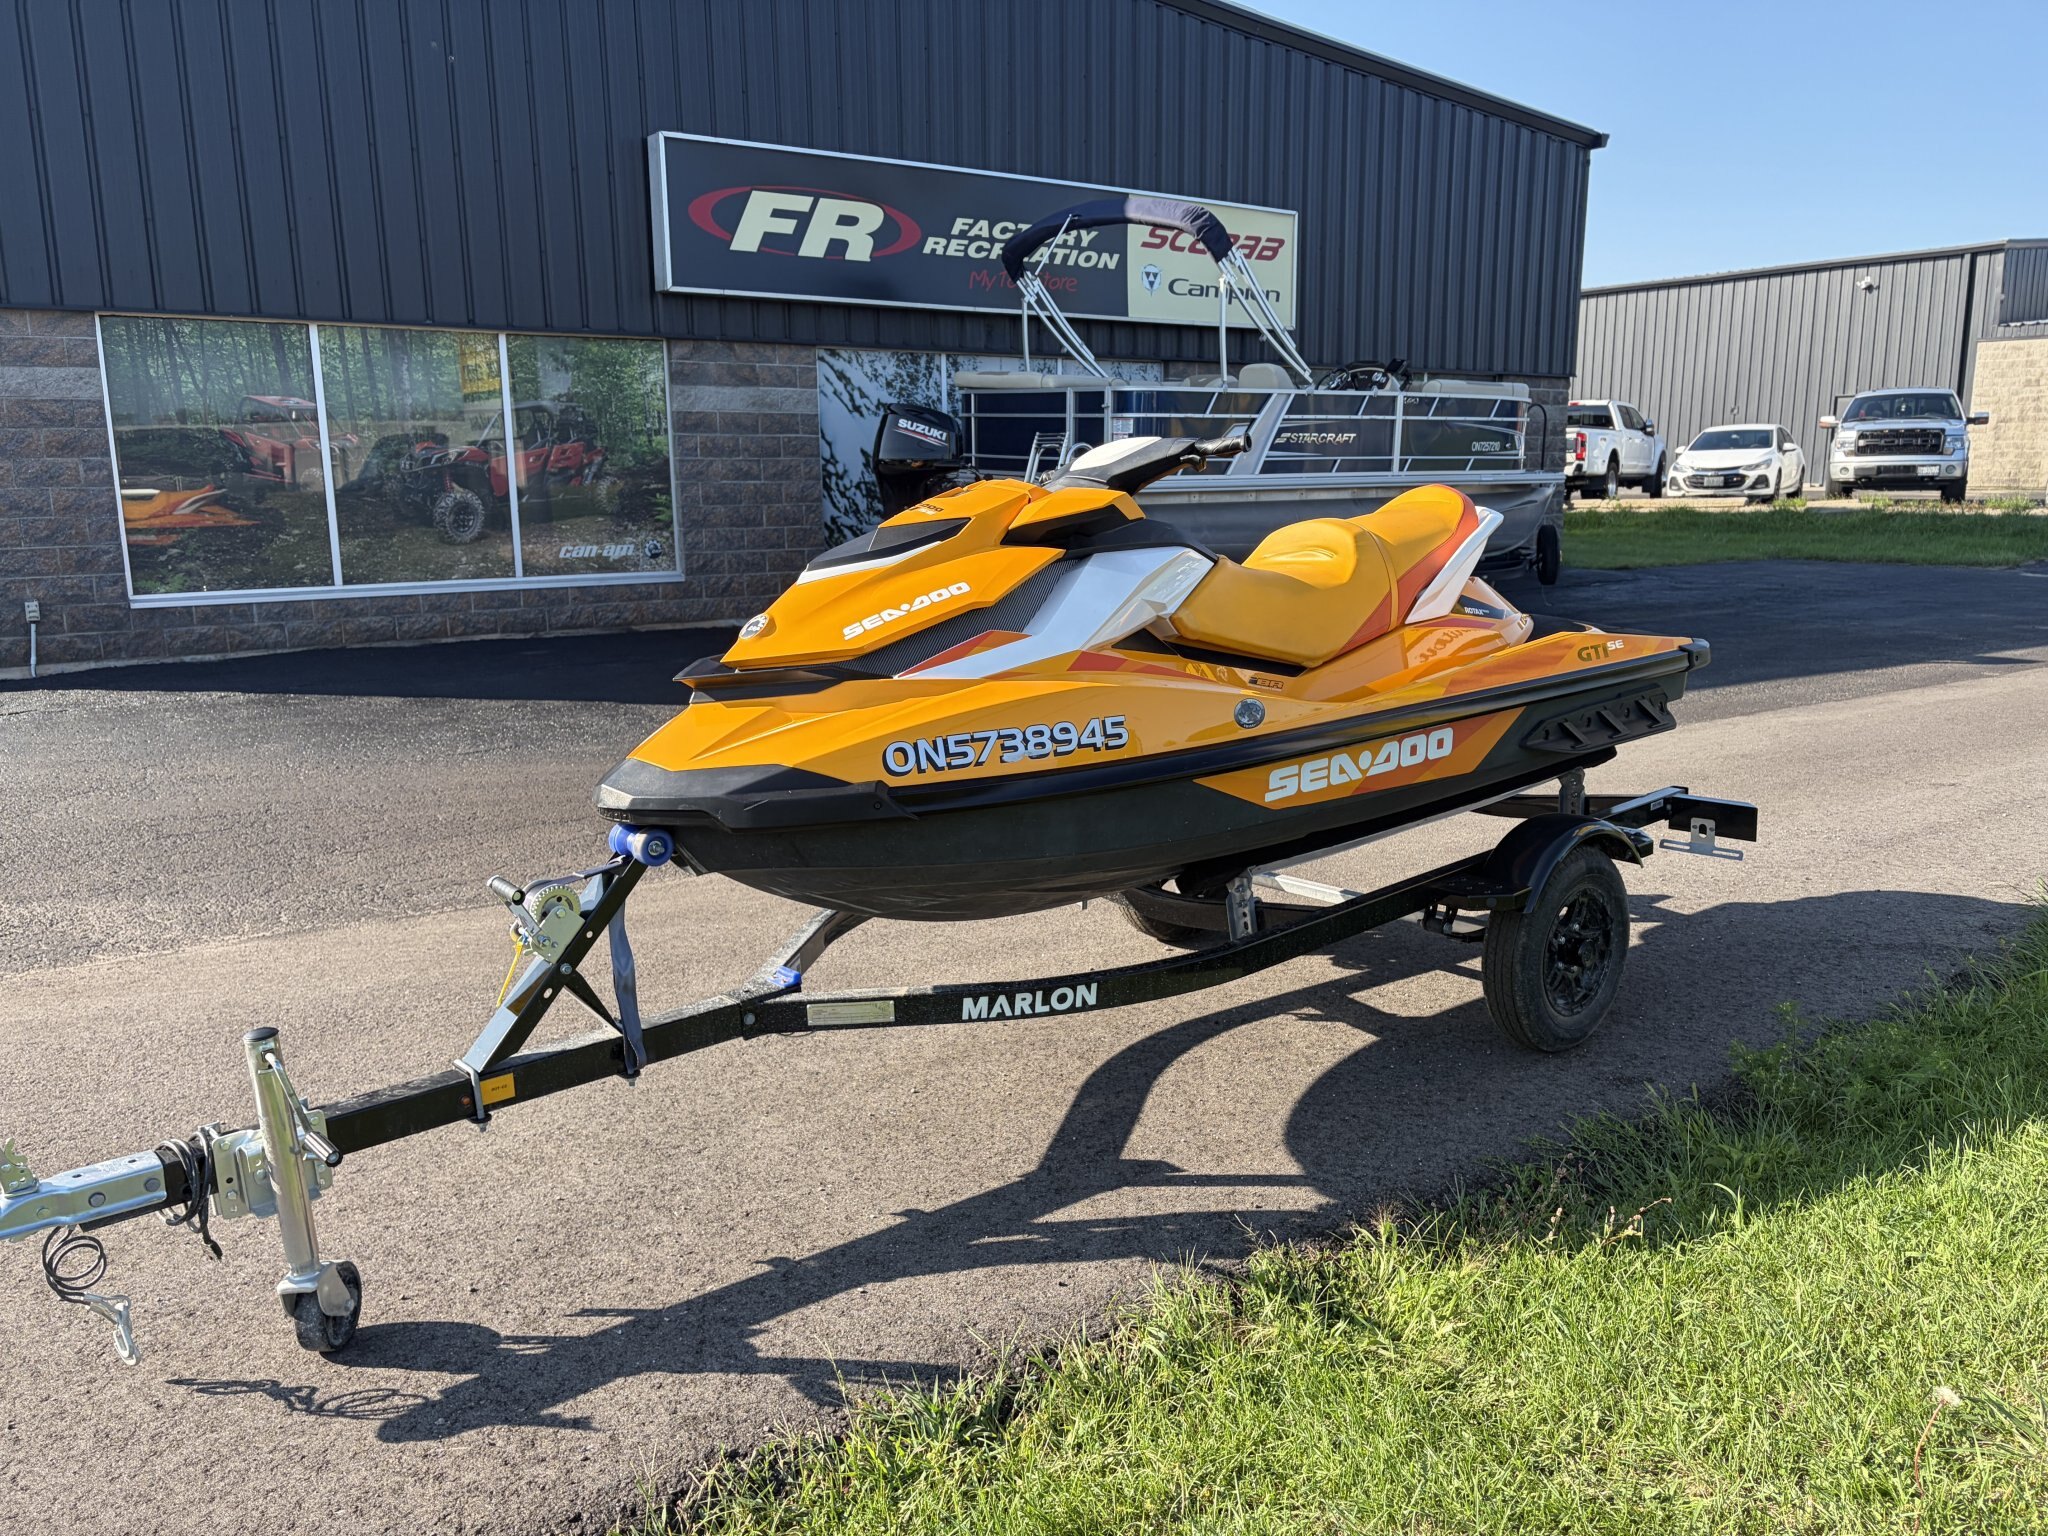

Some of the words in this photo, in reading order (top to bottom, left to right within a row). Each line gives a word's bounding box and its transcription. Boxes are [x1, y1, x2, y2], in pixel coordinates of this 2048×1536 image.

[729, 190, 884, 262] FR
[951, 217, 1099, 247] FACRY
[923, 237, 1120, 270] RECATION
[1140, 227, 1286, 262] SCAAB
[969, 270, 997, 292] My
[1040, 271, 1079, 292] tore
[898, 418, 947, 441] SUZUKI
[1289, 433, 1357, 445] STARCRAFT
[559, 544, 635, 561] can-am
[1577, 643, 1610, 662] GTI
[1606, 639, 1625, 651] SE
[882, 715, 1130, 778] ON5738945
[961, 982, 1098, 1020] MARLON
